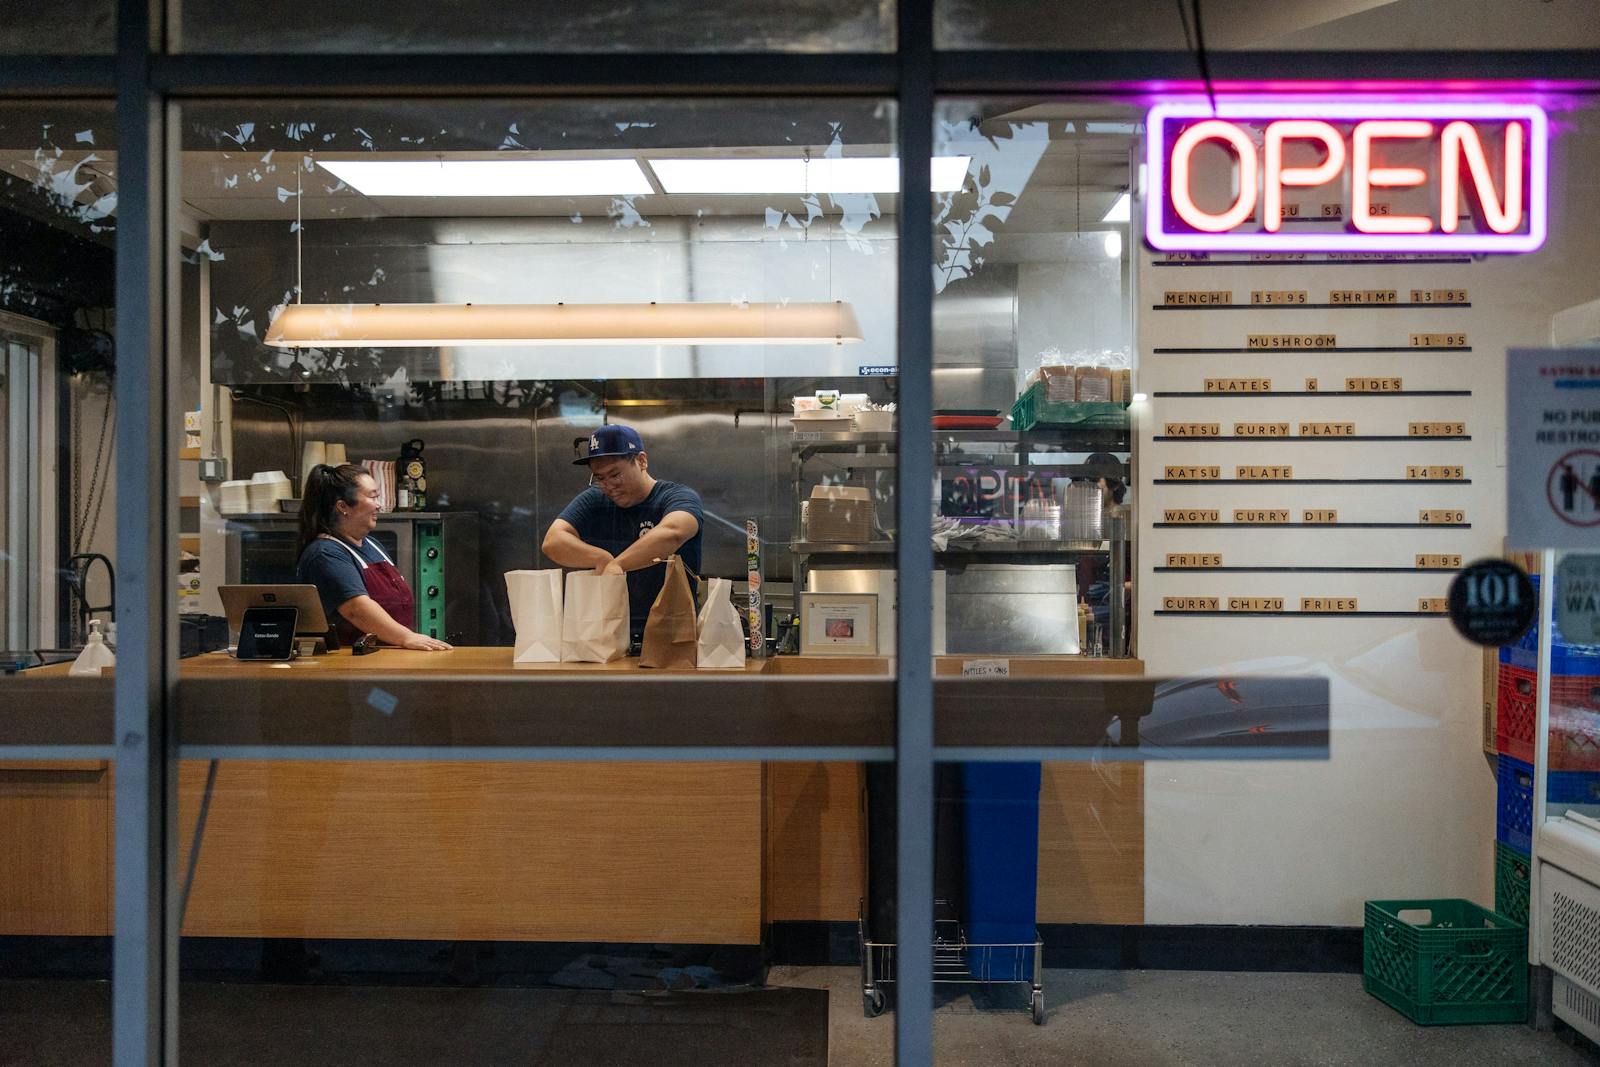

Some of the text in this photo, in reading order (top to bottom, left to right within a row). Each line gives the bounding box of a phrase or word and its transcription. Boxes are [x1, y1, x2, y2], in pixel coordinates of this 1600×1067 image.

[1170, 119, 1523, 234] OPEN
[1325, 206, 1387, 216] SAOS
[1165, 293, 1230, 304] MENCHI
[1332, 291, 1396, 303] SHRIMP
[1248, 336, 1336, 348] MUSHROOM
[1206, 379, 1402, 391] PLATES & SIDES
[1543, 410, 1567, 423] NO
[1166, 424, 1220, 436] KATSU
[1235, 424, 1289, 436] CURRY
[1301, 424, 1354, 436] PLATE
[1166, 467, 1220, 479] KATSU
[1238, 467, 1291, 479] PLATE
[1164, 511, 1219, 522] WAGYU
[1235, 511, 1289, 522] CURRY
[1304, 511, 1336, 522] DIP
[1168, 555, 1221, 567] FRIES
[1466, 573, 1520, 607] 101
[1165, 599, 1219, 610] CURRY
[1229, 599, 1283, 610] CHIZU
[1303, 599, 1356, 610] FRIES
